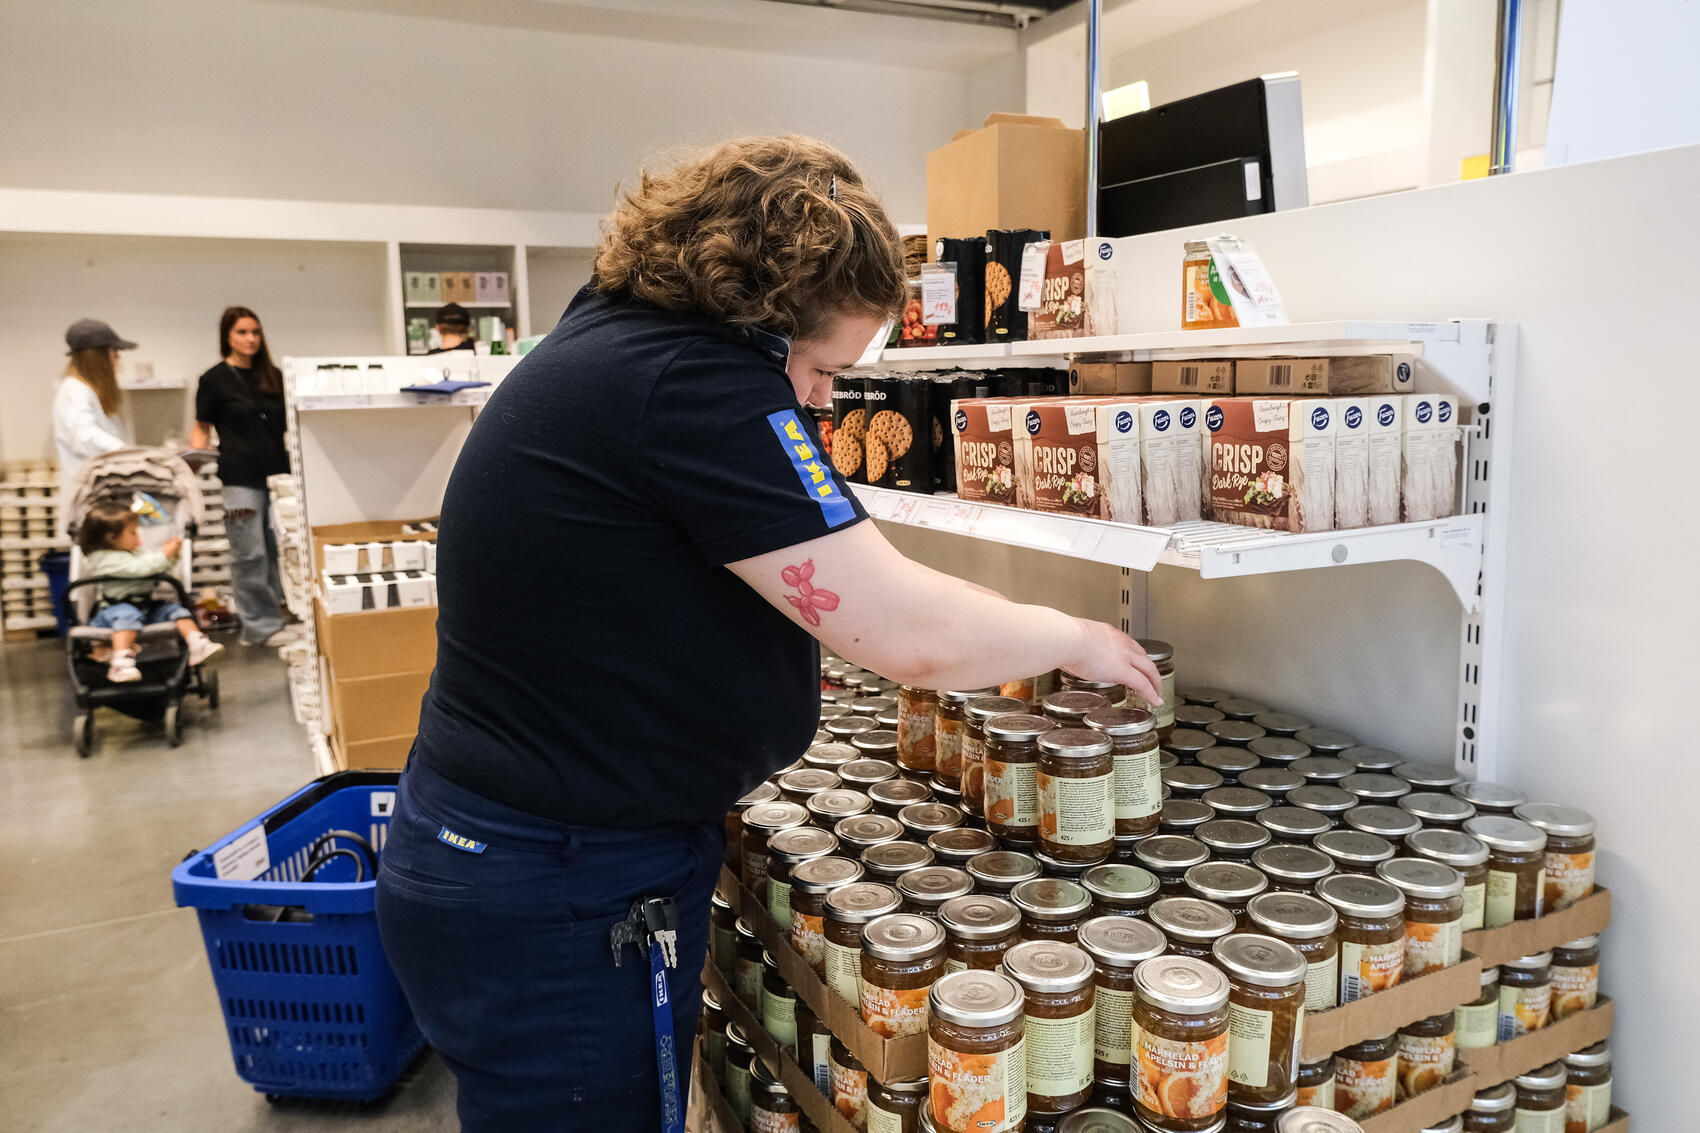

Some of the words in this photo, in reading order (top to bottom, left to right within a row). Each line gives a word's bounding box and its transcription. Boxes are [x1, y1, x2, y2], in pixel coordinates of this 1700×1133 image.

[784, 419, 833, 498] IKEA
[961, 441, 996, 468] CRISP
[1033, 446, 1077, 475] CRISP
[1212, 443, 1263, 474] CRISP
[963, 467, 977, 482] Dark
[1035, 474, 1052, 491] Dark
[1052, 475, 1066, 491] Rye
[1212, 472, 1232, 490] Dark
[1232, 474, 1249, 491] Rye
[442, 830, 476, 849] IKEA
[881, 1008, 889, 1016] &
[890, 1006, 925, 1016] FLÄDER
[1144, 1041, 1199, 1061] MARMELAD
[1145, 1051, 1186, 1069] APELSIN
[1188, 1061, 1196, 1069] &
[943, 1069, 951, 1078] &
[952, 1071, 991, 1083] FLÄDER
